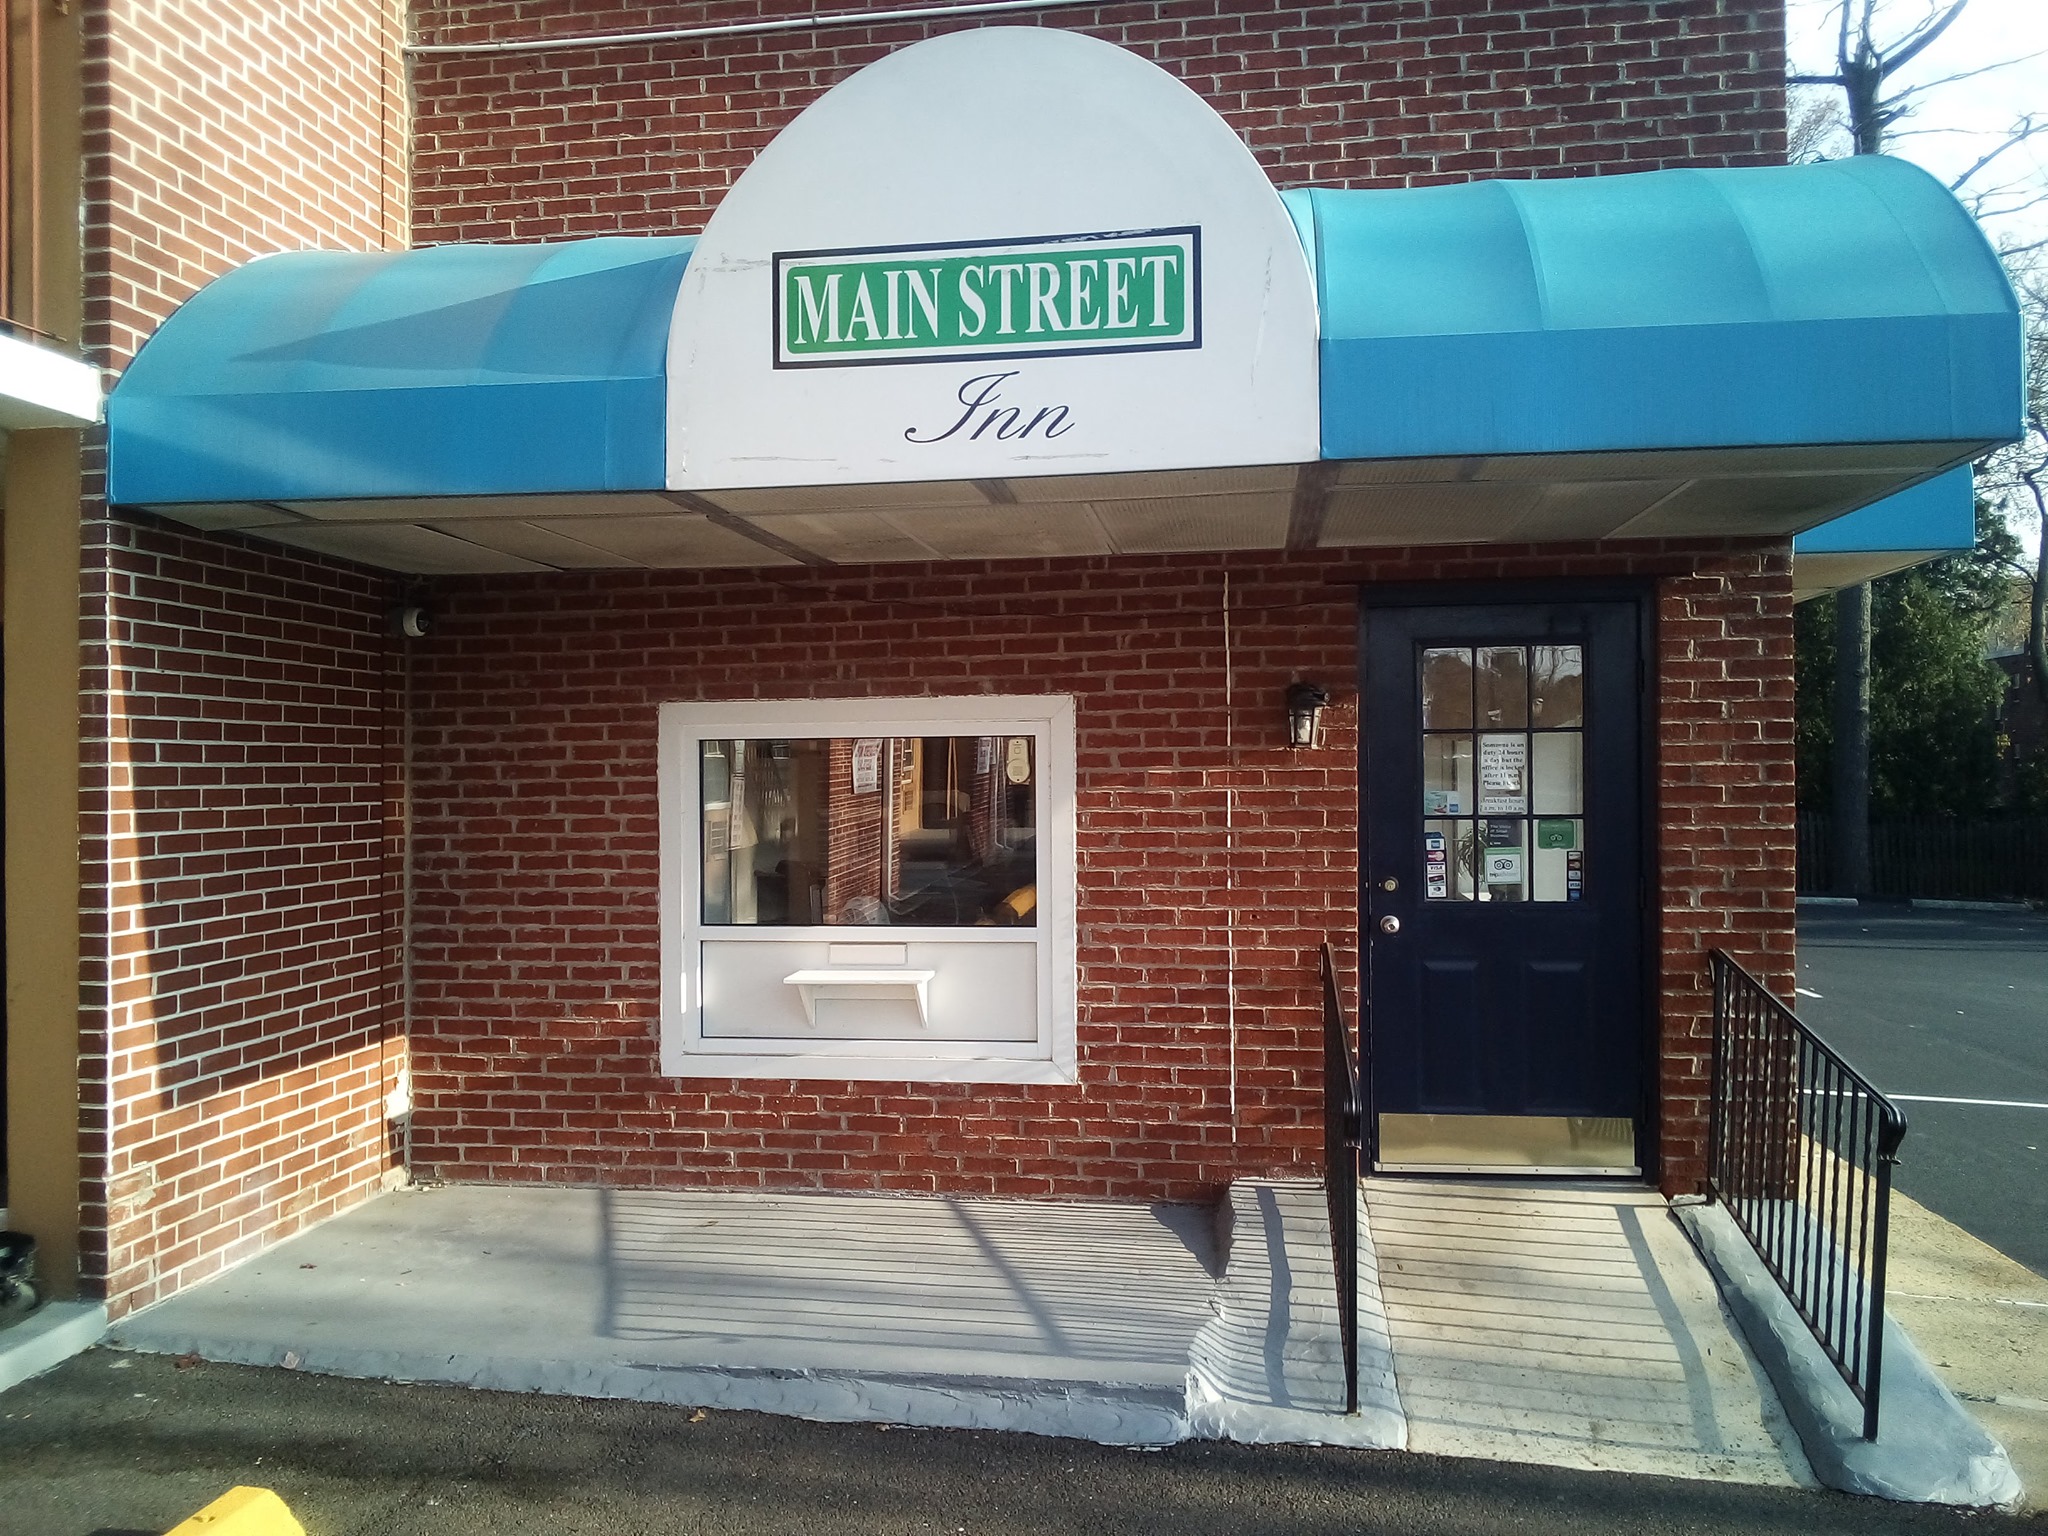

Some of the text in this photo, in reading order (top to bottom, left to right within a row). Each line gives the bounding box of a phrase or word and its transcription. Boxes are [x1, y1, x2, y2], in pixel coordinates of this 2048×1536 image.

[794, 255, 1178, 345] MAIN STREET
[904, 371, 1076, 443] Inn
